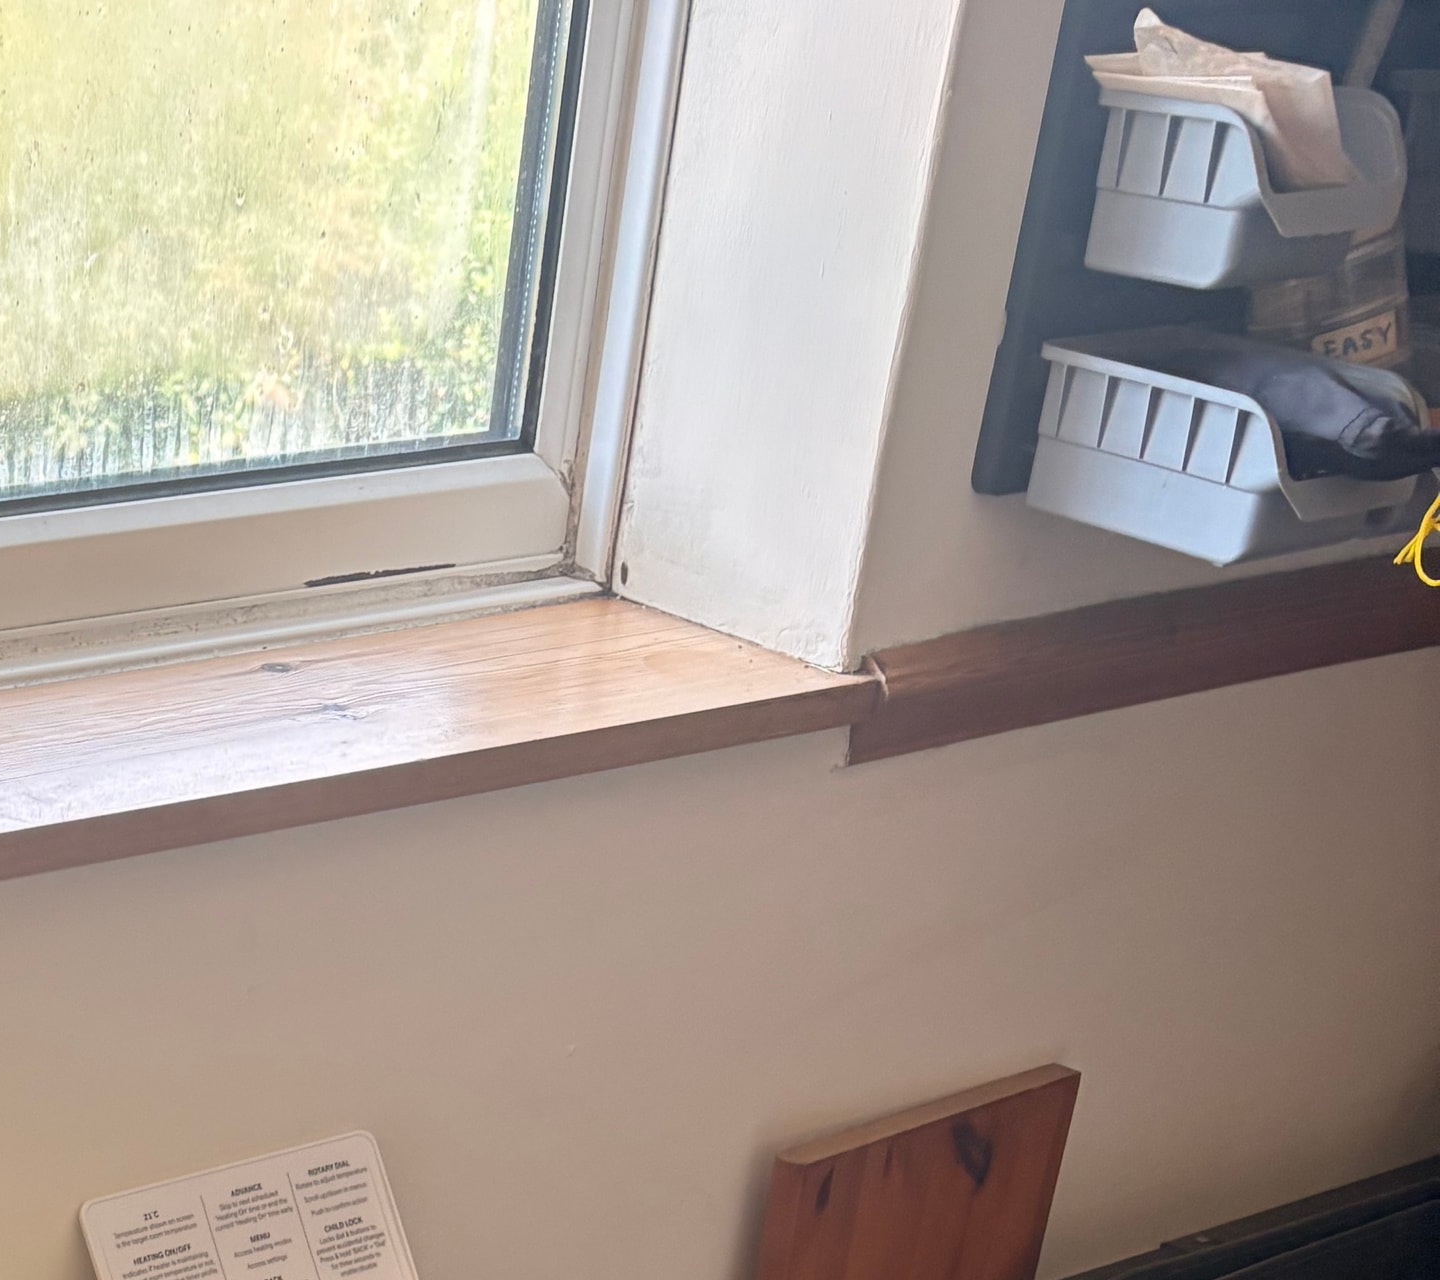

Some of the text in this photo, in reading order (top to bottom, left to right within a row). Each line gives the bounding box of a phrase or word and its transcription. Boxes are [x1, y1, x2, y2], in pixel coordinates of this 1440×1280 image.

[1323, 321, 1392, 358] EASY
[308, 1160, 349, 1175] ROTARY DIAL
[231, 1183, 262, 1196] ADVANCE
[295, 1181, 312, 1190] Rotate
[320, 1174, 335, 1184] adjust
[238, 1197, 250, 1205] next
[251, 1190, 278, 1202] scheduled
[303, 1193, 319, 1203] Scroll
[310, 1208, 324, 1216] Push
[113, 1226, 148, 1239] Temperature
[149, 1221, 167, 1230] shown
[175, 1214, 194, 1223] screen
[324, 1216, 363, 1232] CHILD LOCK
[131, 1235, 148, 1244] target
[149, 1231, 163, 1240] room
[163, 1223, 197, 1235] temperature
[249, 1232, 270, 1242] MENU
[319, 1236, 335, 1245] Locks
[349, 1226, 369, 1236] buttons
[233, 1238, 292, 1258] Access heating modes
[316, 1232, 385, 1256] prevent accidental changes
[133, 1243, 190, 1264] HEATING ON/OFF
[319, 1255, 335, 1263] Press
[338, 1259, 353, 1267] three
[353, 1253, 375, 1264] seconds
[122, 1268, 148, 1279] Indicates
[153, 1262, 170, 1270] heater
[176, 1251, 208, 1263] maintaining
[247, 1254, 287, 1269] Access settings
[163, 1264, 197, 1277] temperature
